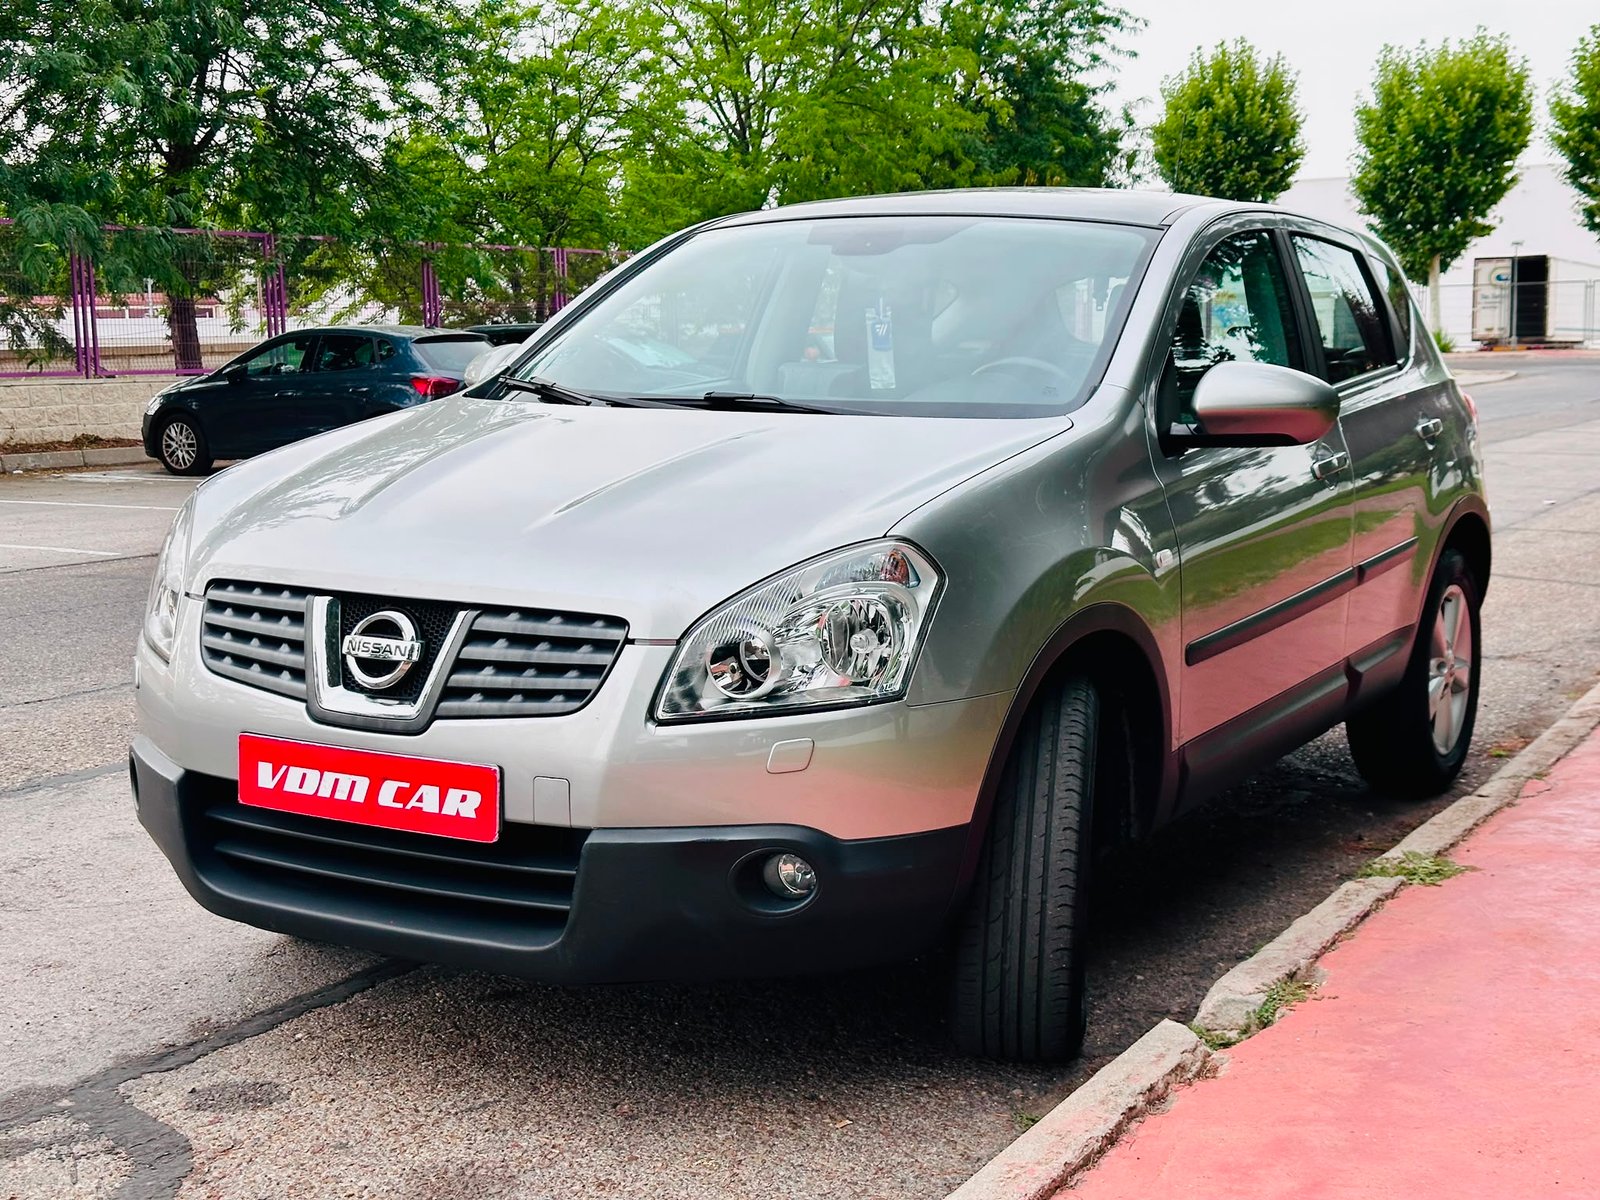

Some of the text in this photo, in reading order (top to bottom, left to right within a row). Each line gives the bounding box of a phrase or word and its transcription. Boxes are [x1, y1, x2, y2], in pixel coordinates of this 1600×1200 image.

[346, 639, 408, 657] NISSAN
[257, 761, 482, 819] VDM CAR
